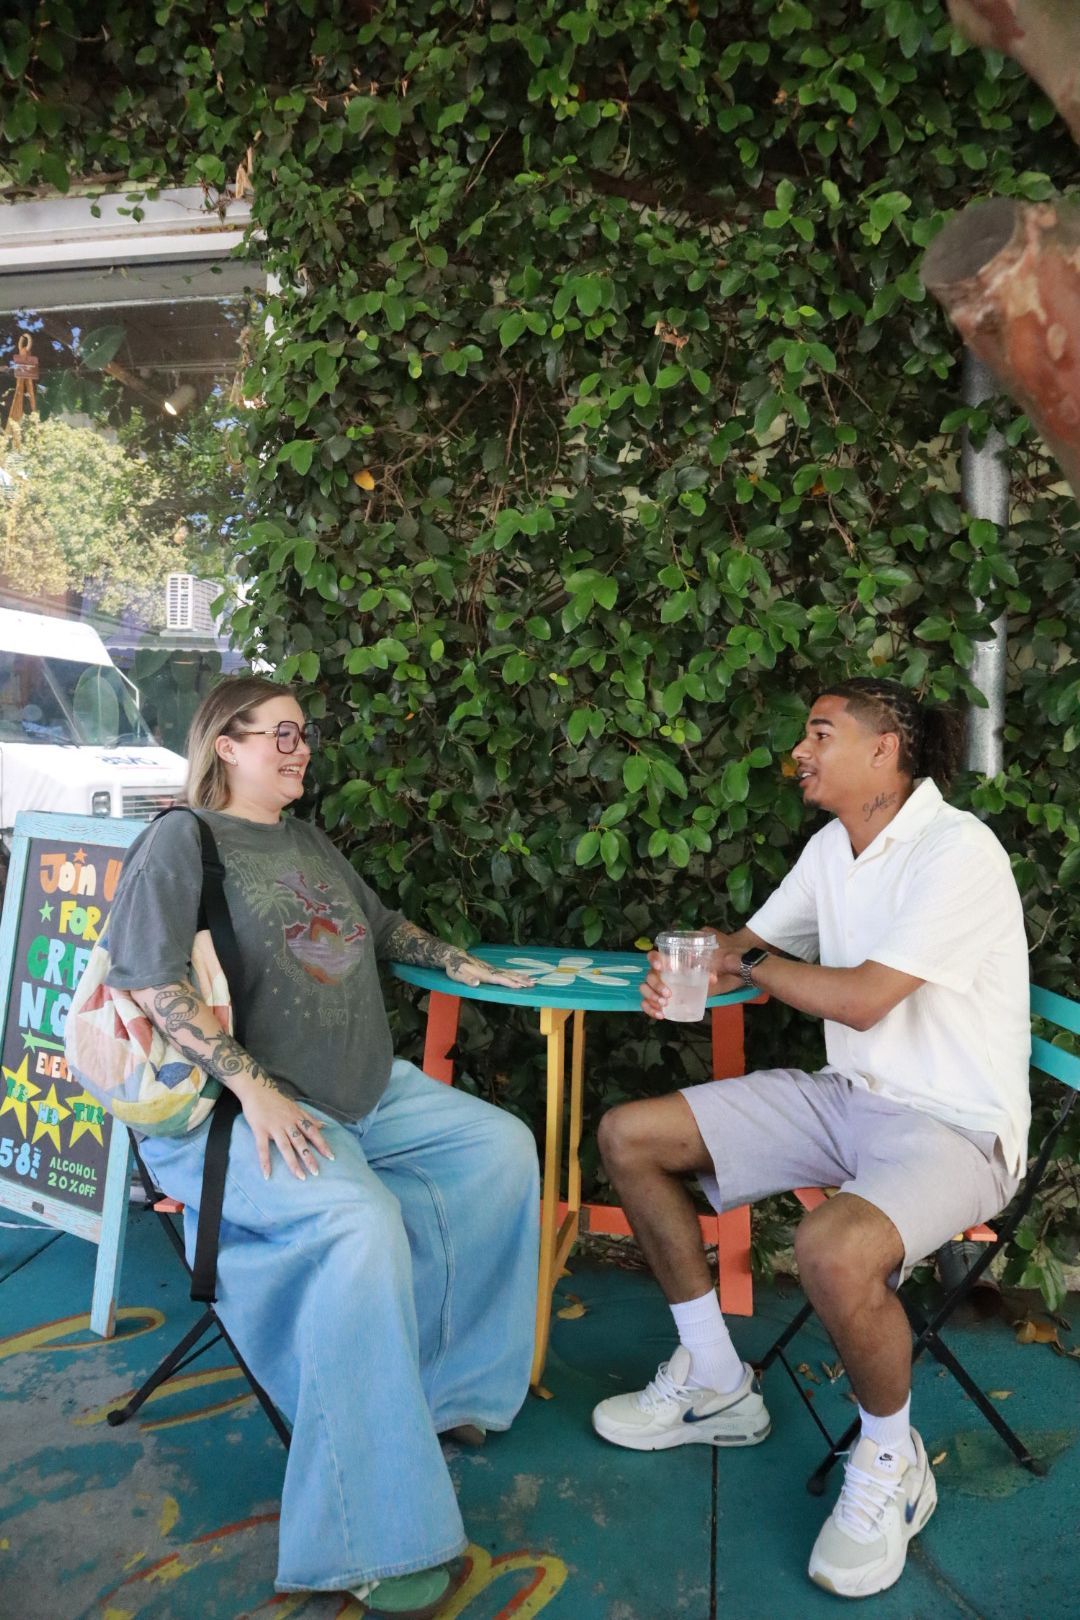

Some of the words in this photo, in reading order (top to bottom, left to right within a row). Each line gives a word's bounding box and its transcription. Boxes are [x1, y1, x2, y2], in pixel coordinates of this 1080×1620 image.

[58, 900, 101, 941] FOR
[27, 934, 92, 990] CRAF
[49, 1156, 98, 1181] ALCOHOL
[78, 1182, 97, 1198] OFF
